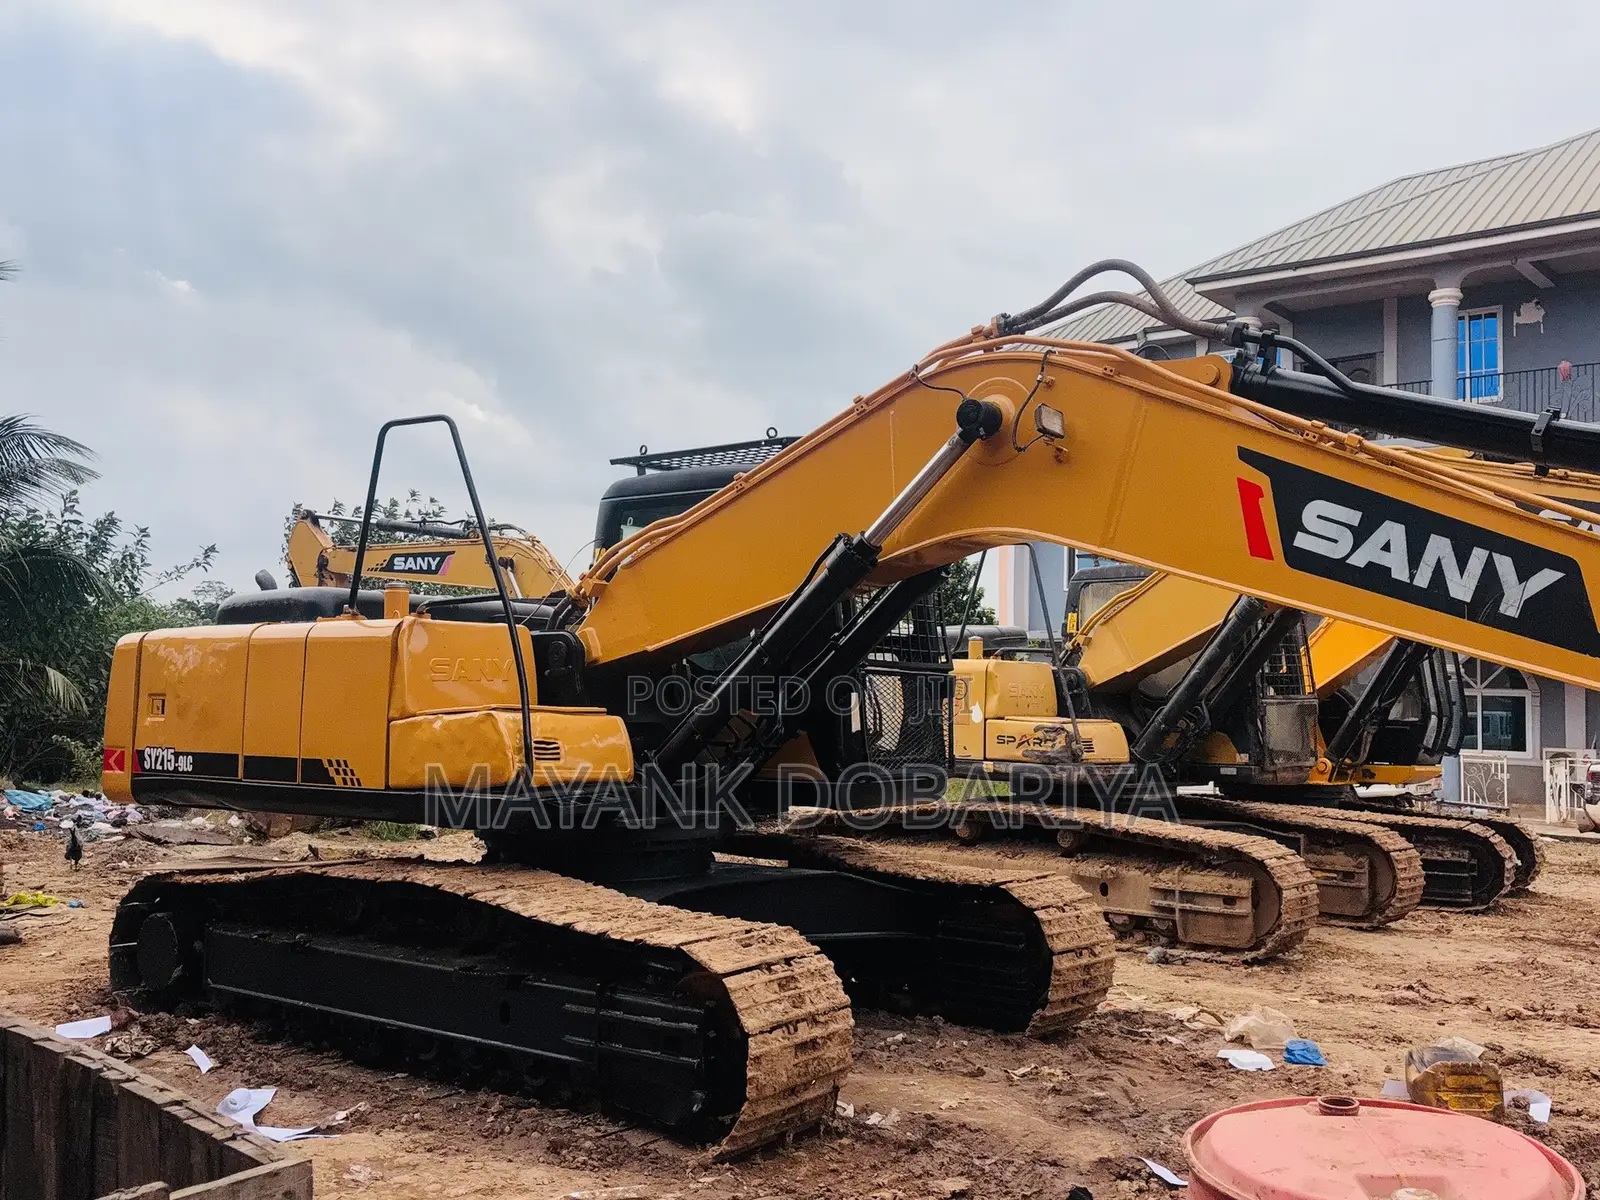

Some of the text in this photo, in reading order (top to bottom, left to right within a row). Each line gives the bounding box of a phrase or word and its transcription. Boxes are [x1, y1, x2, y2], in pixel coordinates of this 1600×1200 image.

[393, 556, 441, 571] SANY
[1293, 499, 1566, 619] SANY
[429, 657, 514, 682] SANY
[143, 747, 194, 772] SY215-9LC
